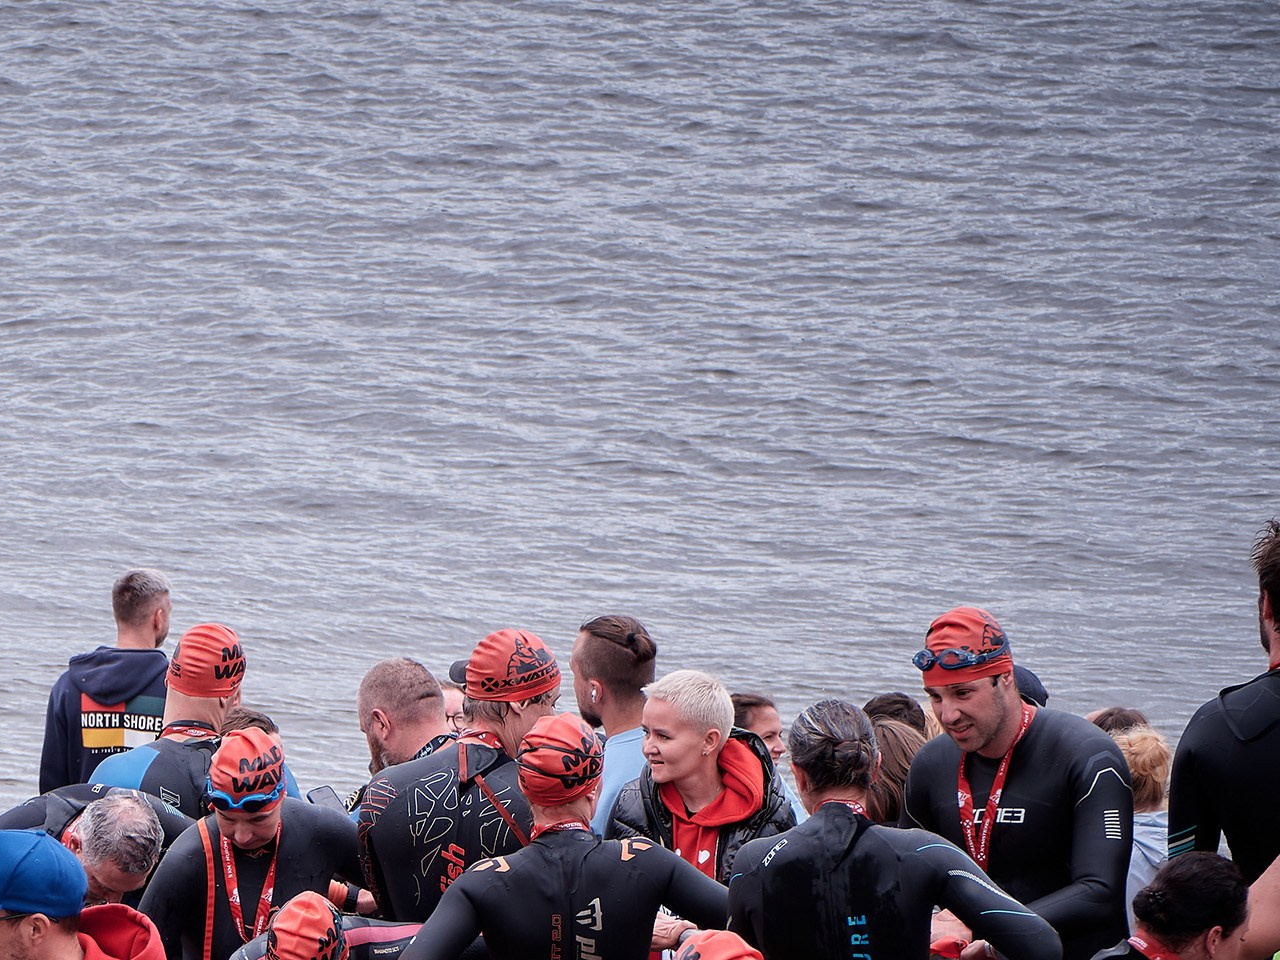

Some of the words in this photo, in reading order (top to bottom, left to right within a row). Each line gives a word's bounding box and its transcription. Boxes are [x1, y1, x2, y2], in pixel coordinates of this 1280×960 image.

[81, 713, 120, 728] NORTH
[124, 714, 163, 731] SHORE
[551, 914, 563, 942] 2.0
